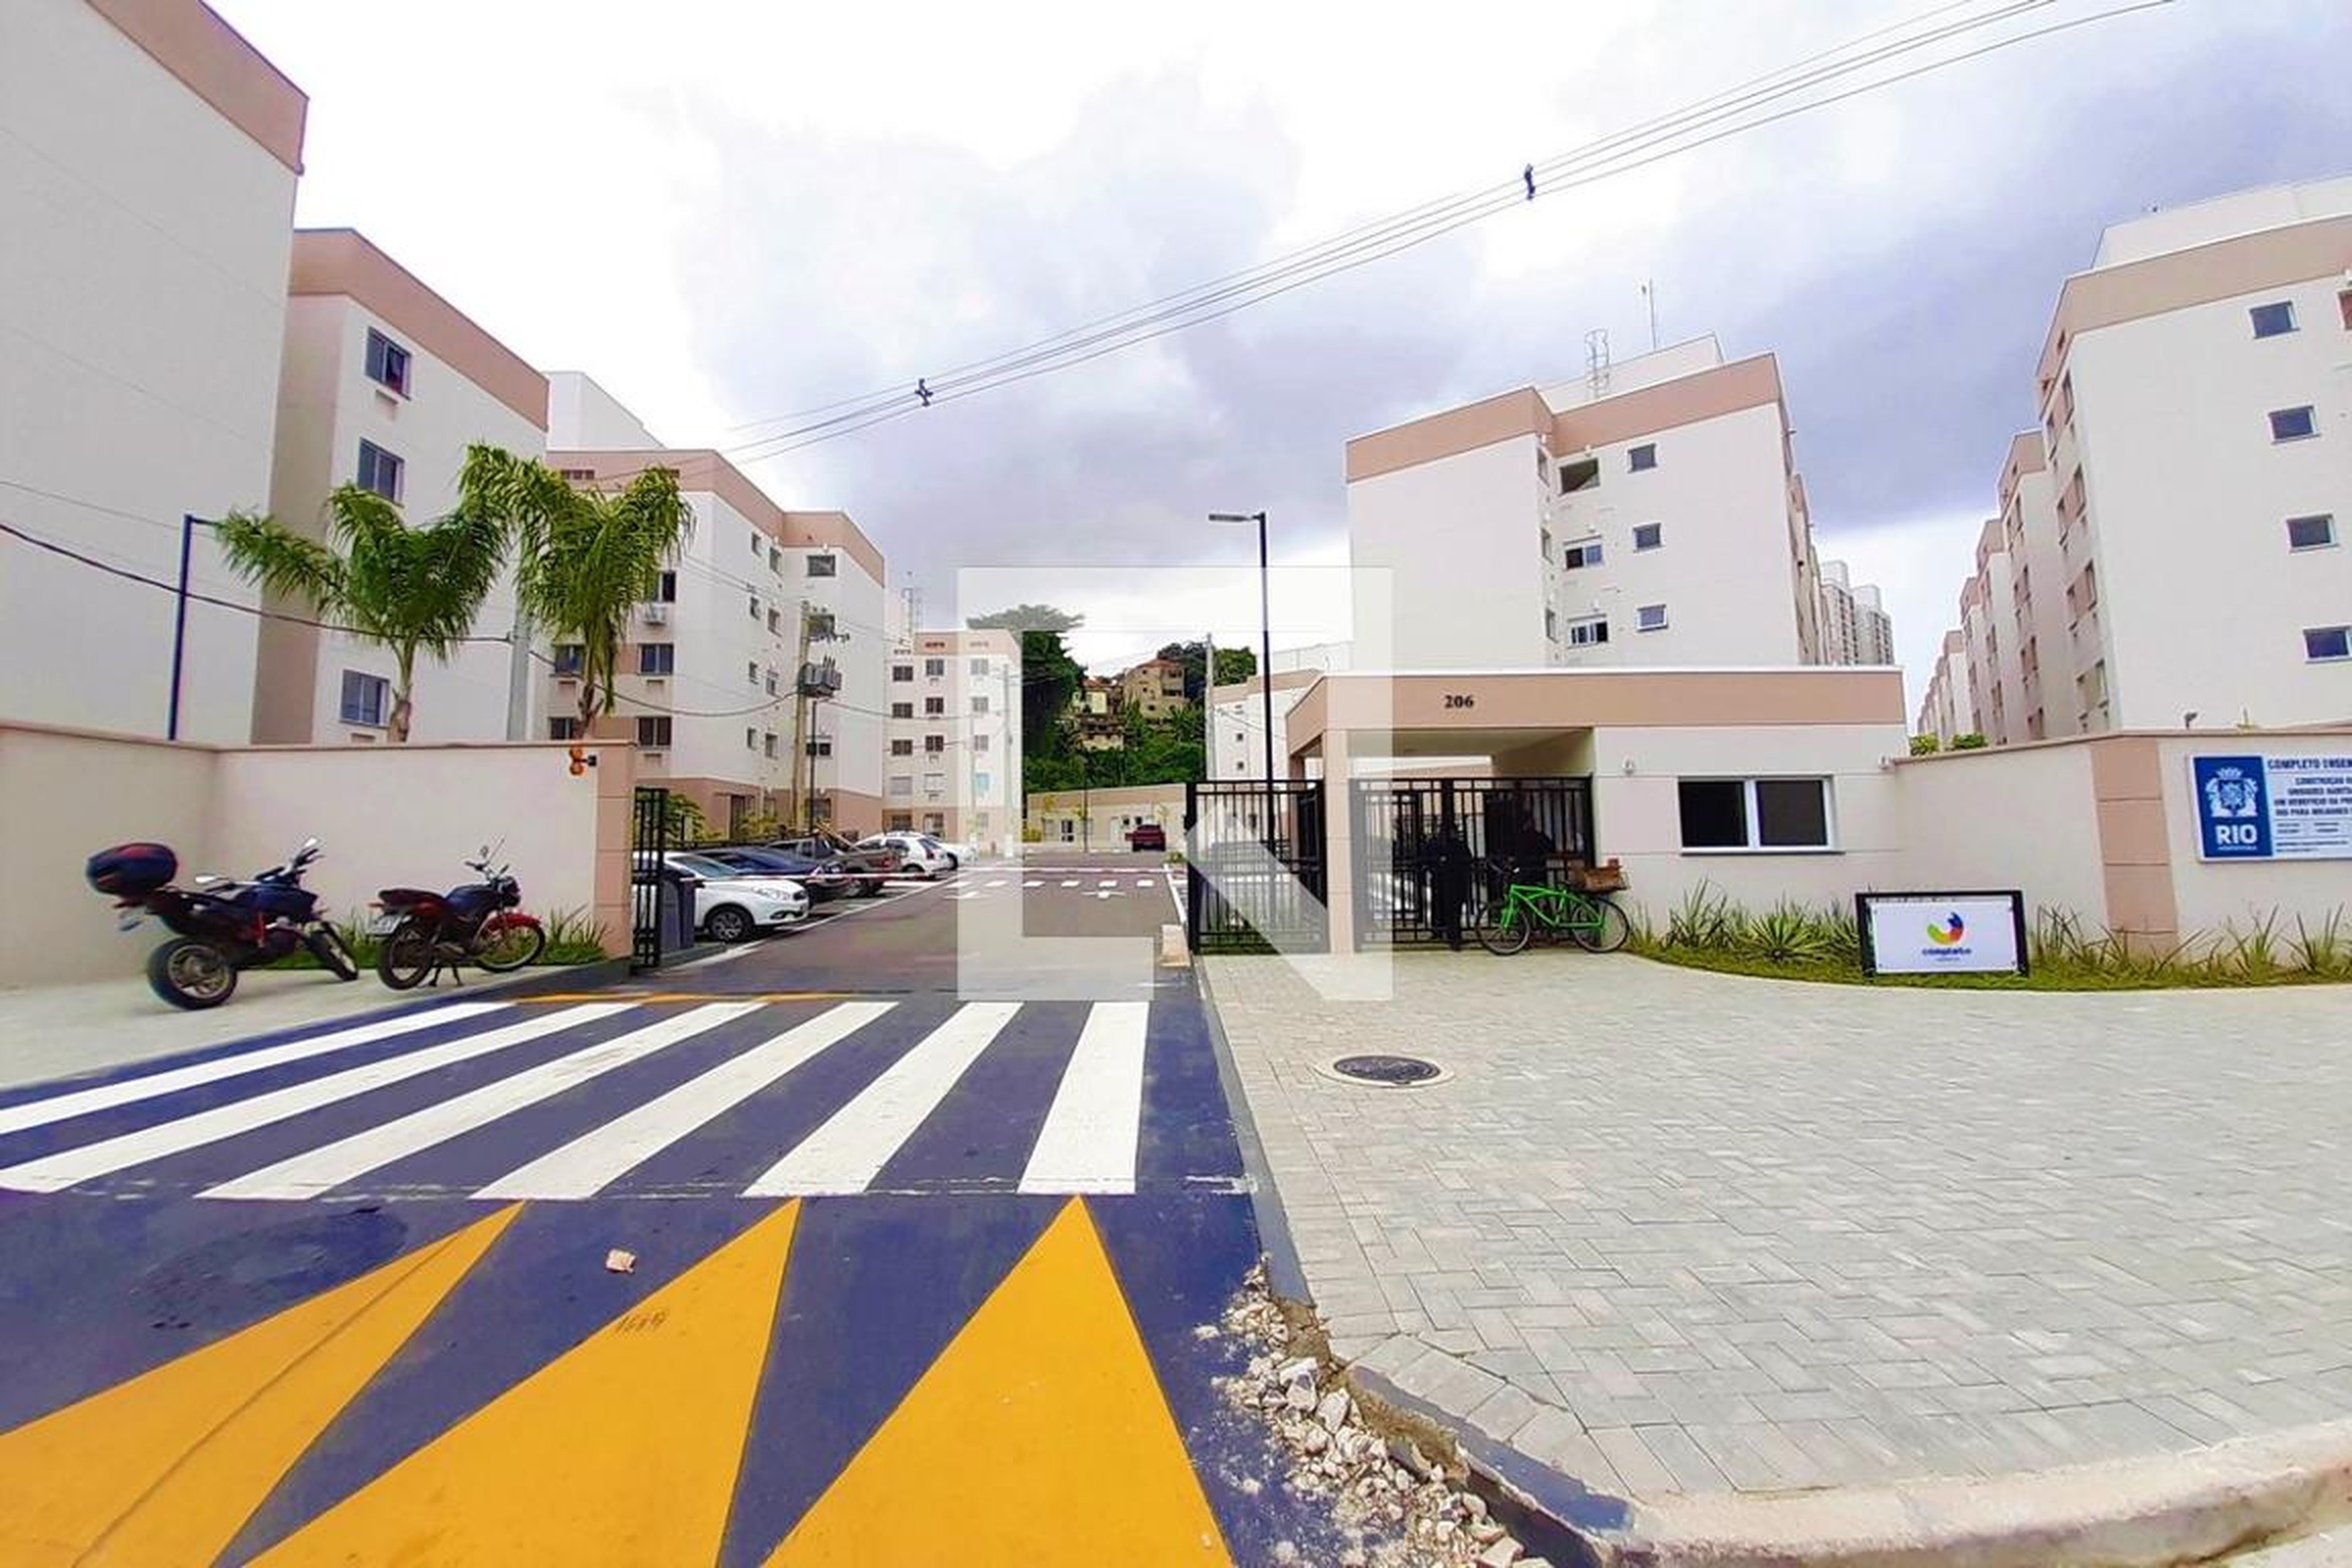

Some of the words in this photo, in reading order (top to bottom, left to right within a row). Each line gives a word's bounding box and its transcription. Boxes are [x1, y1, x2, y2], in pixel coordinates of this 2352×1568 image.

[1444, 695, 1474, 709] 206
[2267, 759, 2320, 769] COMPLETO
[2215, 824, 2257, 844] RIO
